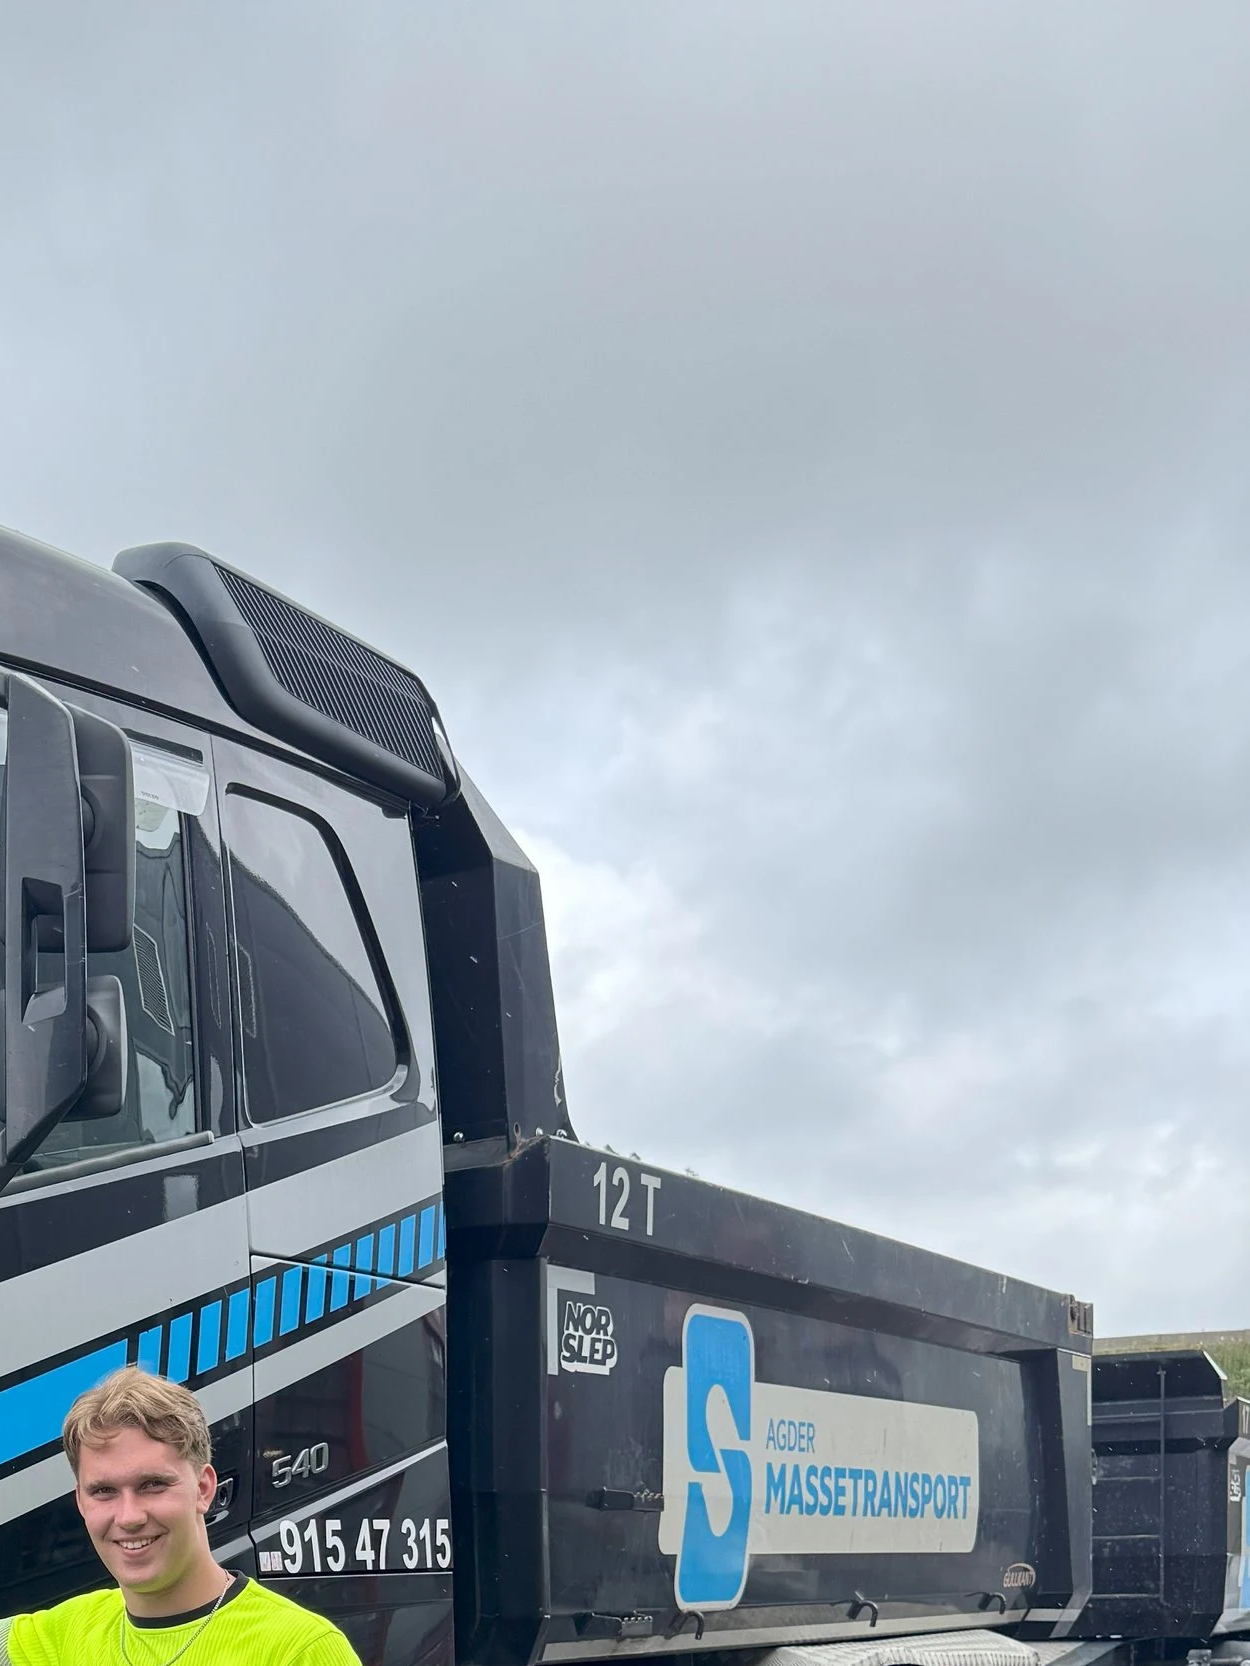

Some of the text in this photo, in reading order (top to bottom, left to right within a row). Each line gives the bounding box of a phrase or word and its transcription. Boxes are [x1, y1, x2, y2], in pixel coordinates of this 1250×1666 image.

[593, 1162, 662, 1236] 12 T
[564, 1301, 613, 1337] NOR
[561, 1332, 616, 1368] SLEP
[766, 1418, 816, 1454] AGDER
[272, 1442, 329, 1489] 540
[765, 1462, 971, 1519] MASSETRANSPORT
[280, 1518, 451, 1574] 915 47 315
